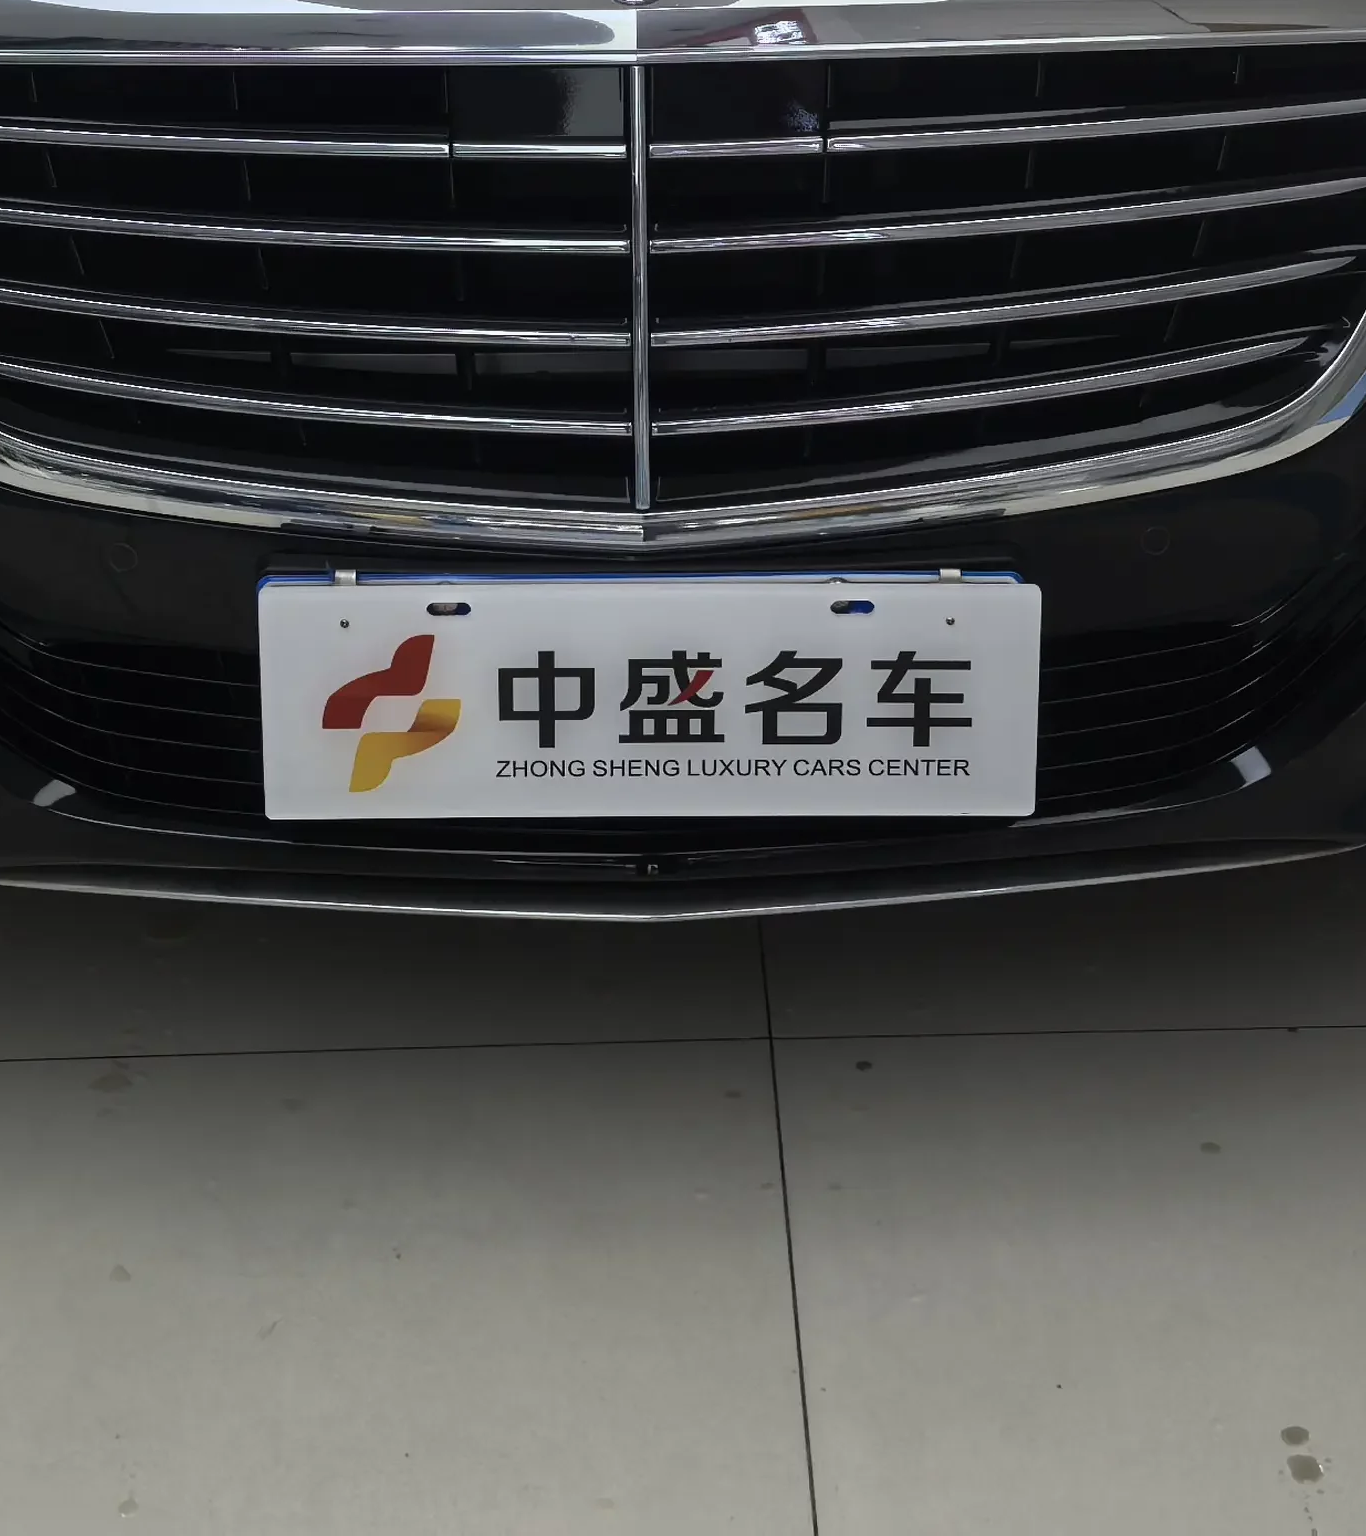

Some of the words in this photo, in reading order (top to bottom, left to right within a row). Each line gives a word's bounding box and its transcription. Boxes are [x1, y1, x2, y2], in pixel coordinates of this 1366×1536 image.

[497, 650, 972, 748] 中盛名车
[495, 758, 585, 778] ZHONG
[592, 758, 679, 778] SHENG
[687, 758, 788, 778] LUXURY
[793, 758, 860, 778] CARS
[868, 758, 970, 778] CENTER
